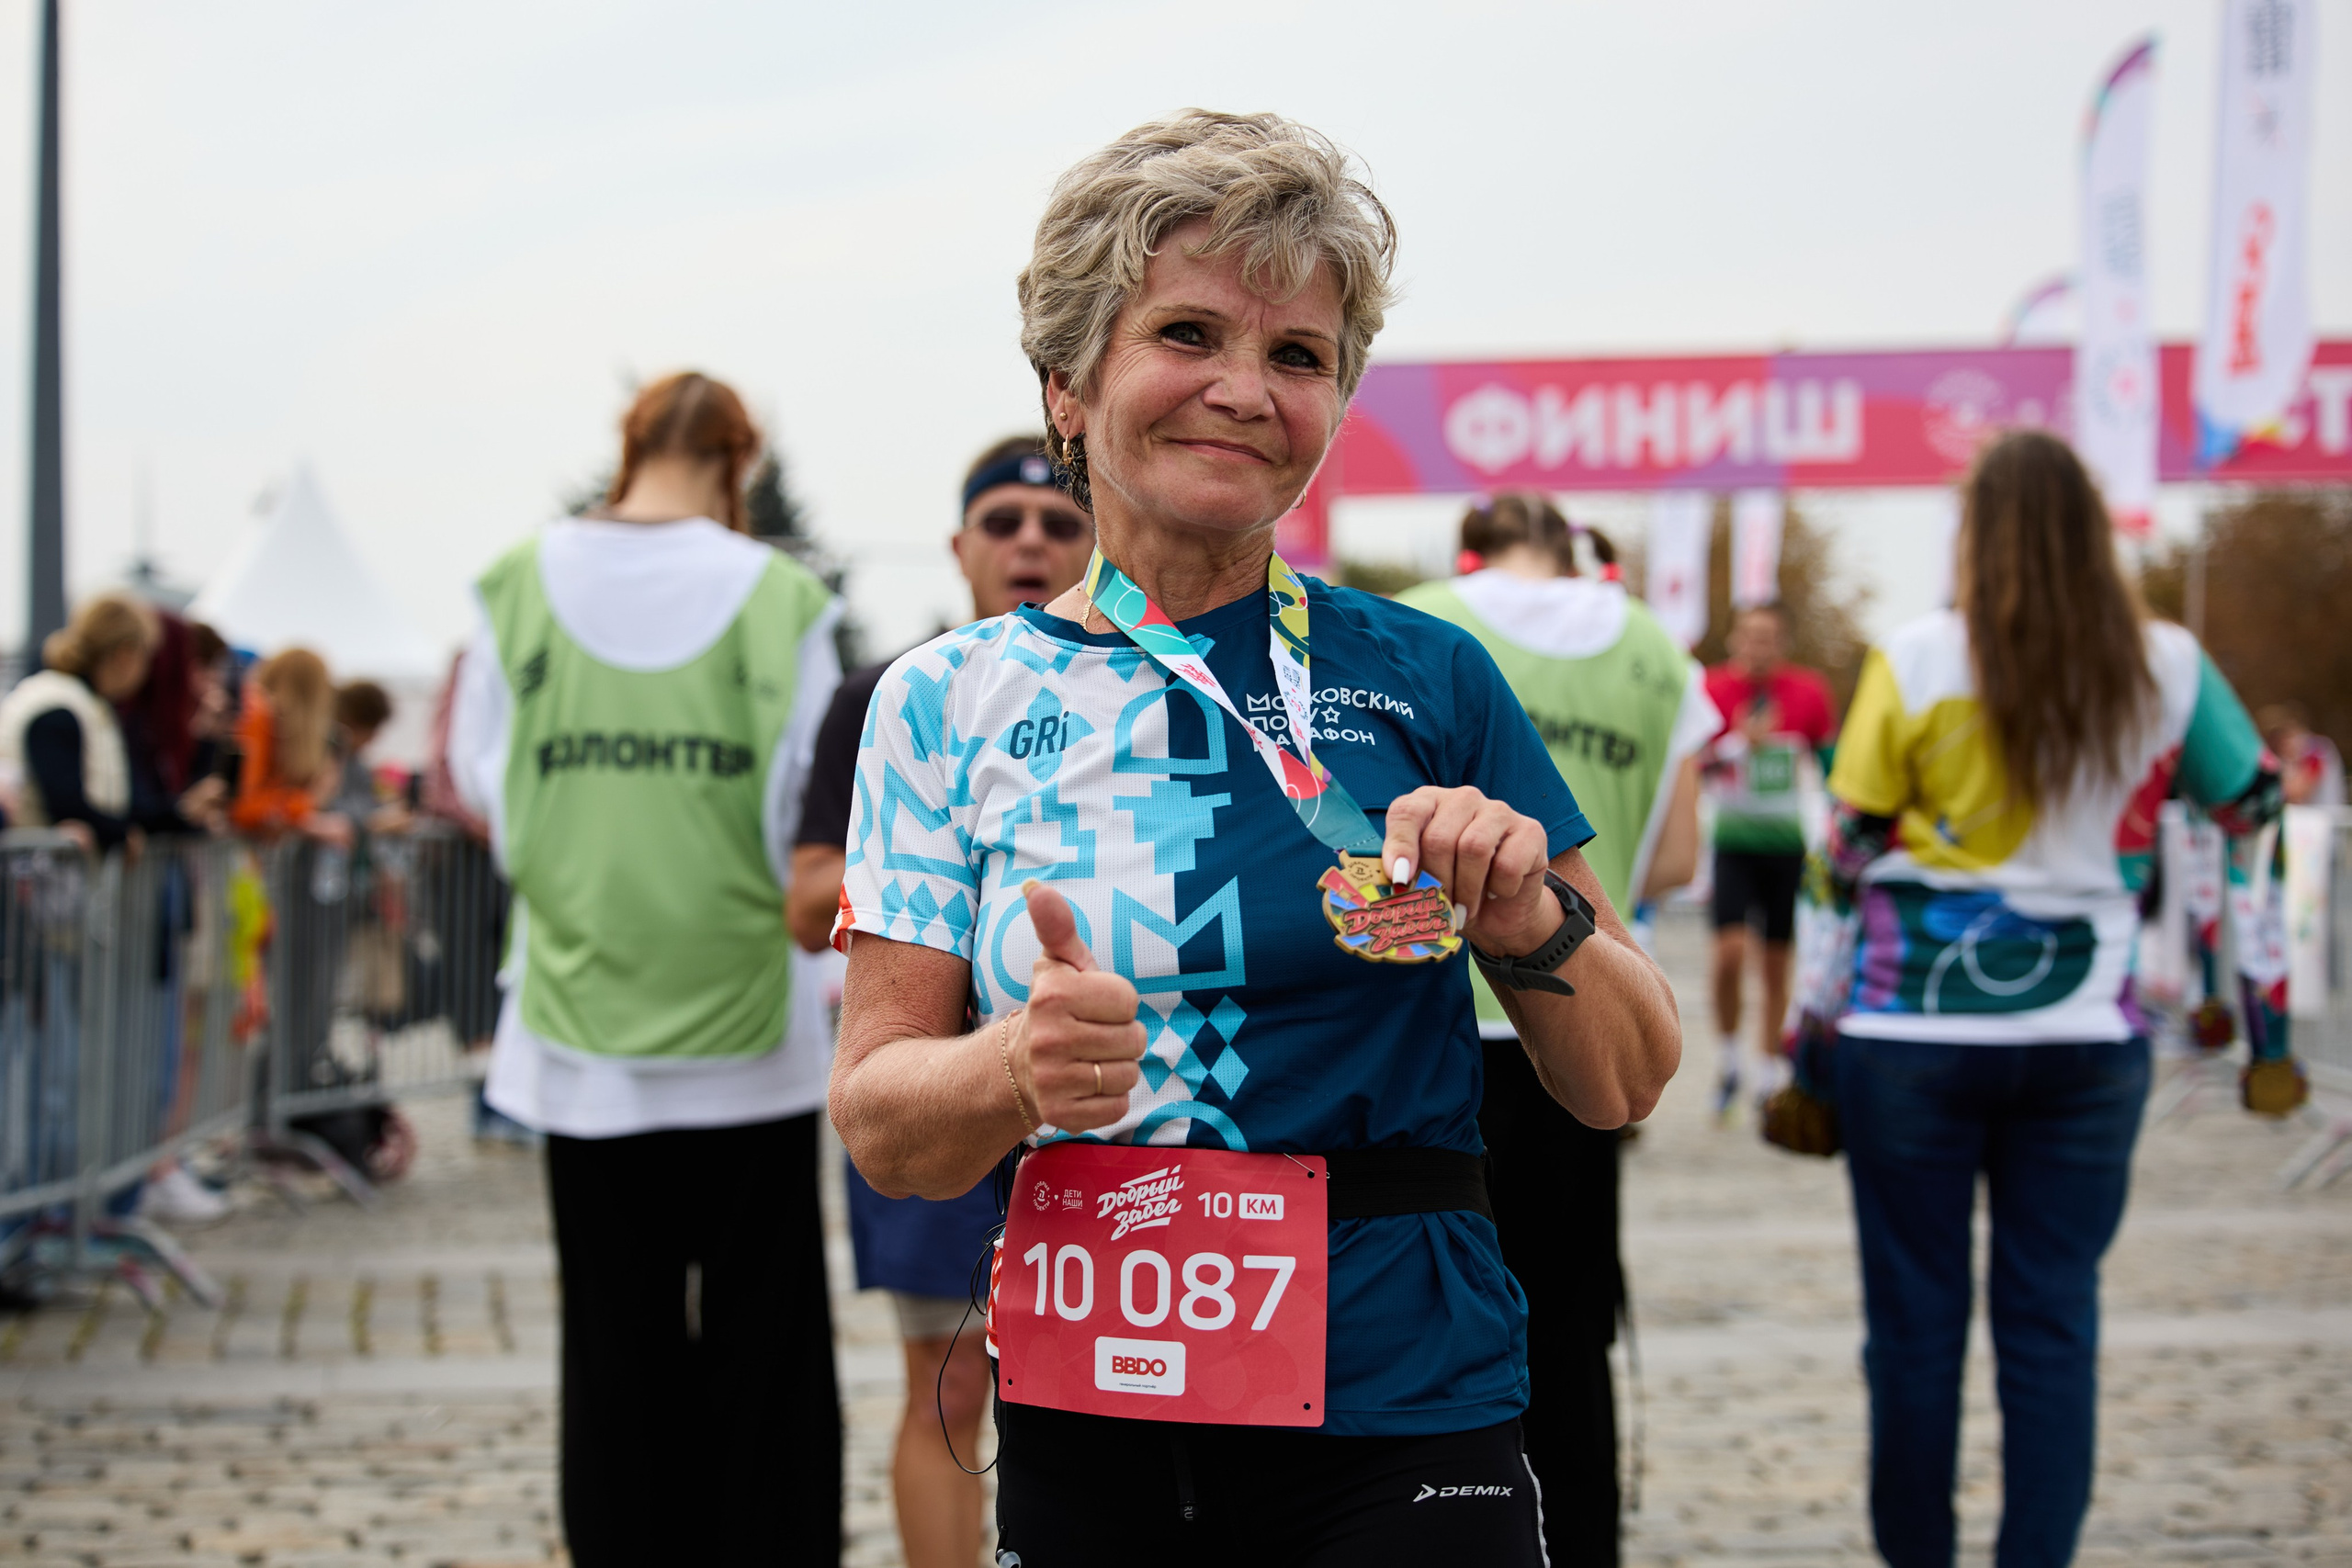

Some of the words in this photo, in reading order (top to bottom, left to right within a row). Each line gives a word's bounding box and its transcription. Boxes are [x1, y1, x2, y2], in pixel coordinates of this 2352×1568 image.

[1443, 378, 1863, 476] ФИНИШ
[1246, 687, 1415, 720] МОКОВСКИЙ
[1253, 727, 1376, 752] ААФОН
[1062, 1198, 1083, 1208] НАШИ
[1063, 1189, 1082, 1199] ДЕТИ
[1097, 1164, 1185, 1219] Добрый
[1198, 1192, 1232, 1218] 10
[1111, 1196, 1182, 1241] забег
[1023, 1242, 1094, 1321] 10
[1120, 1249, 1296, 1331] 087
[1112, 1355, 1167, 1377] BBDO
[1439, 1485, 1514, 1497] DEMIX
[1183, 1506, 1193, 1521] RU
